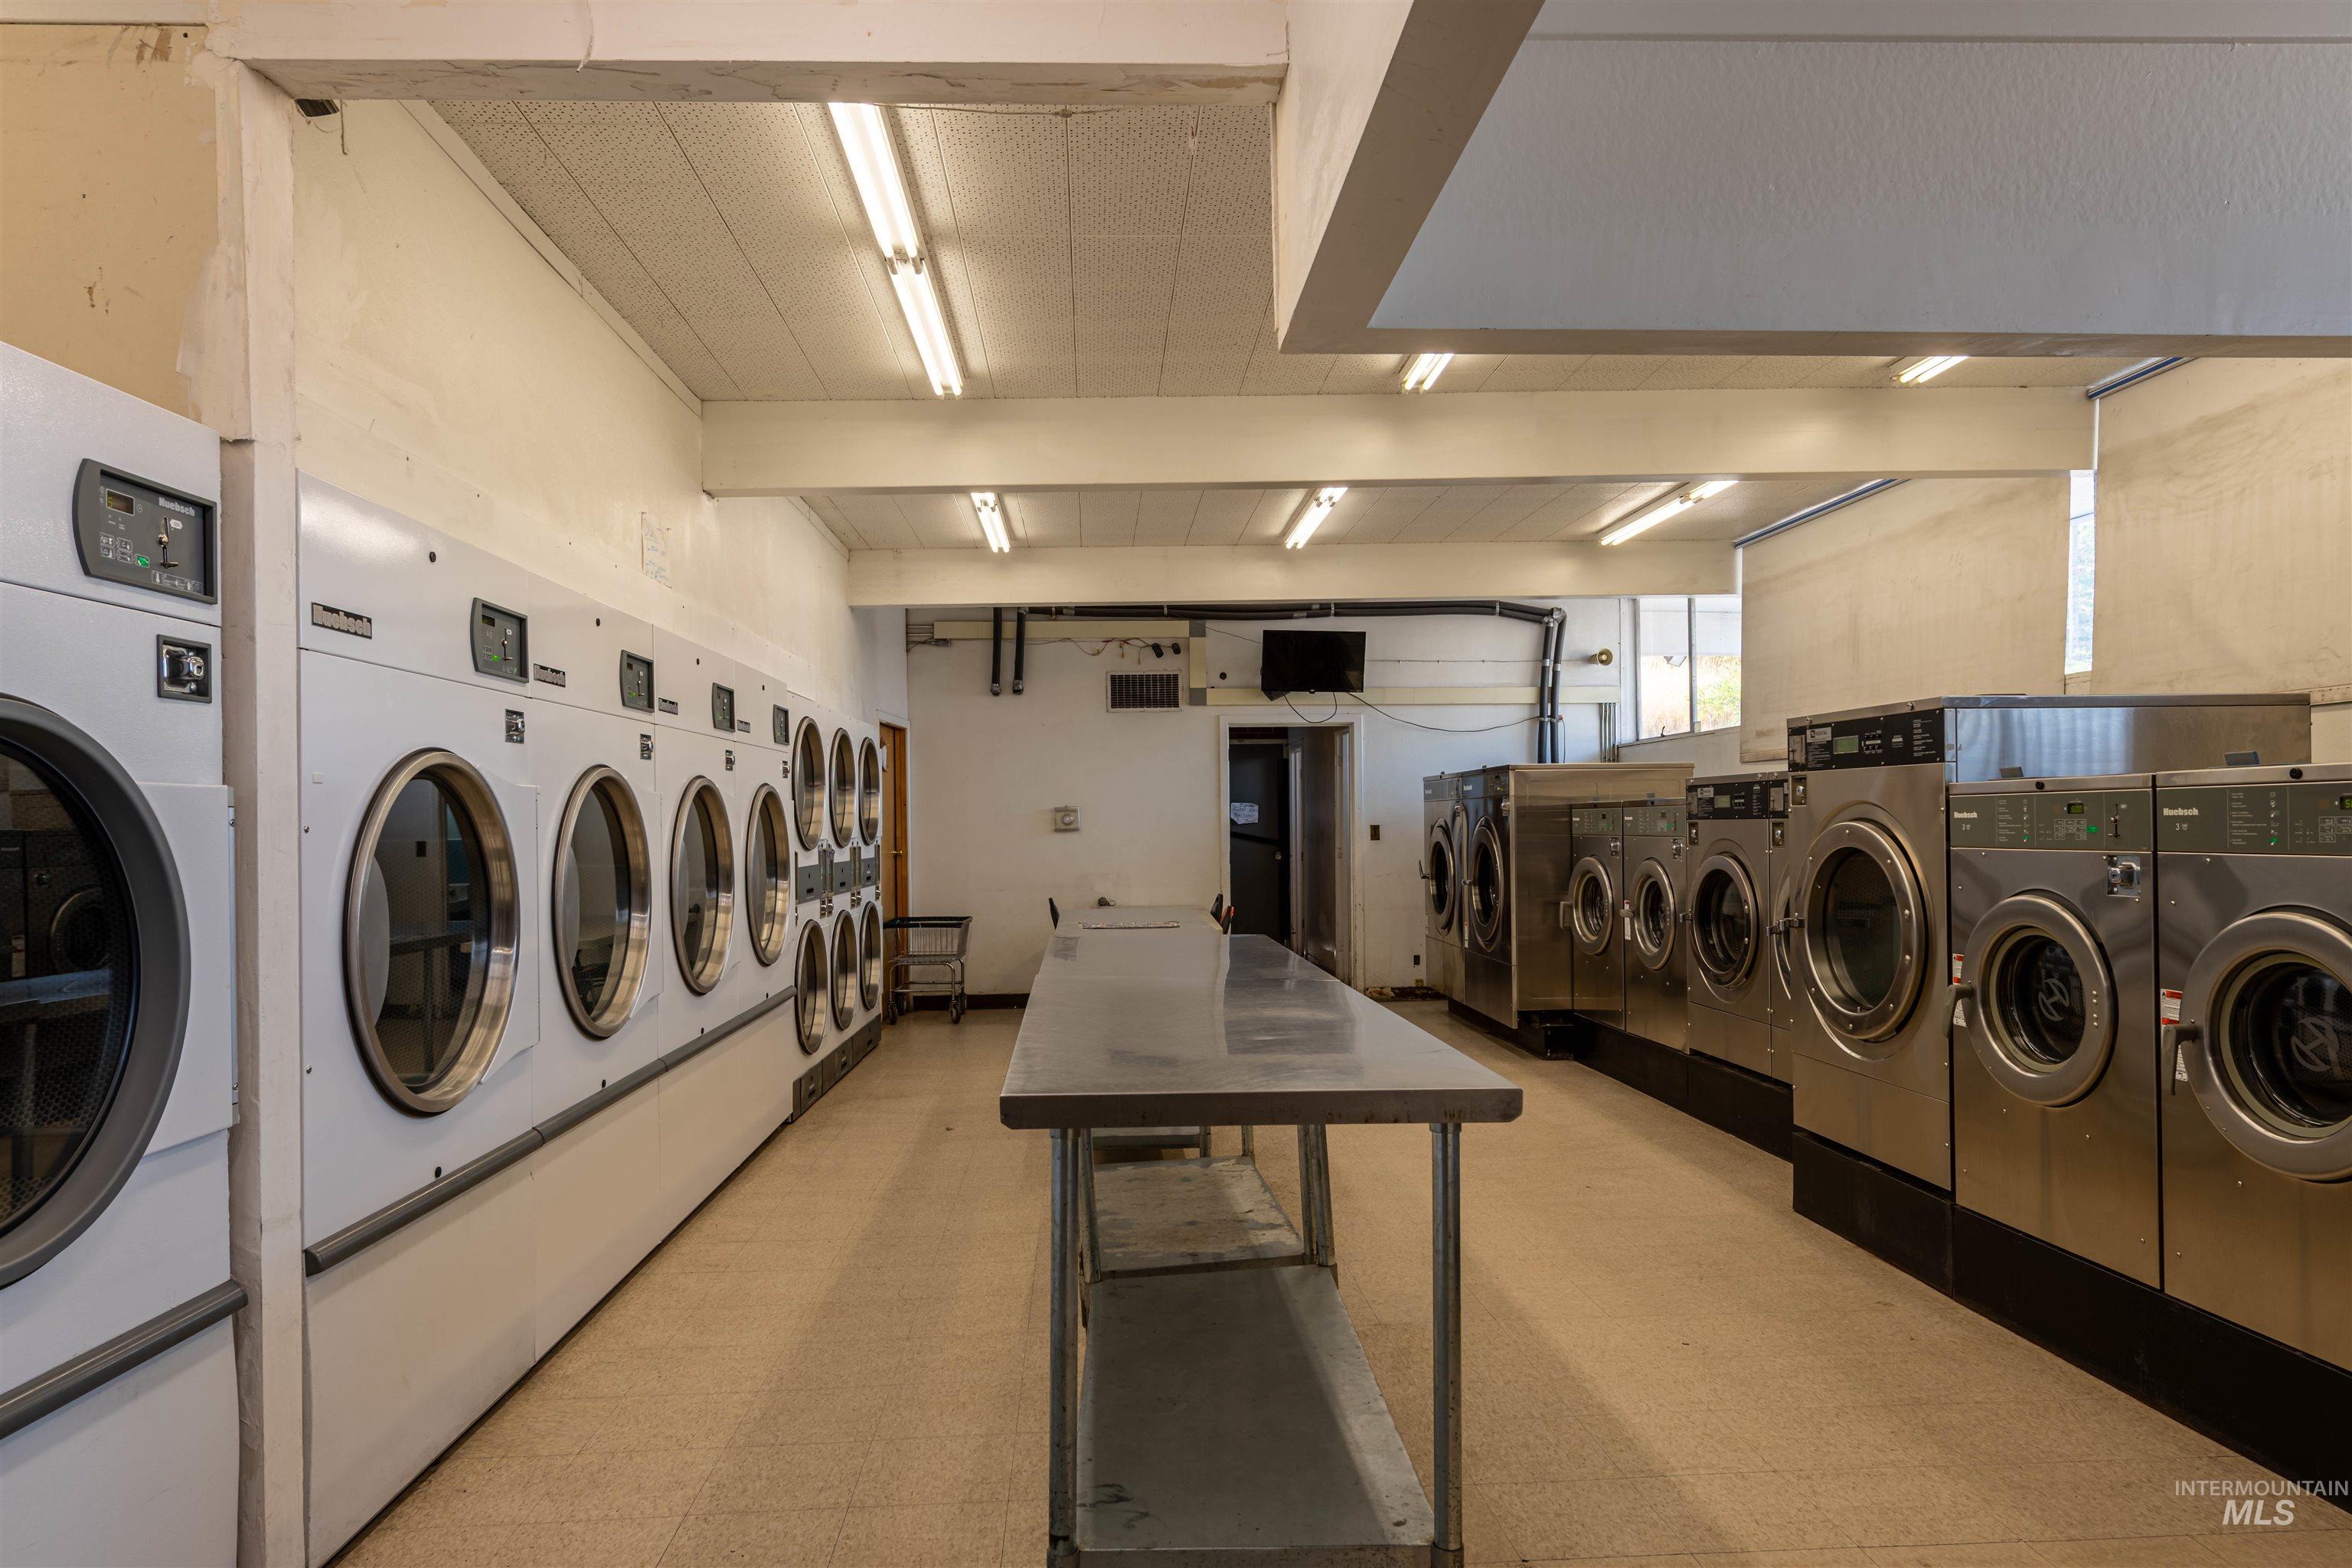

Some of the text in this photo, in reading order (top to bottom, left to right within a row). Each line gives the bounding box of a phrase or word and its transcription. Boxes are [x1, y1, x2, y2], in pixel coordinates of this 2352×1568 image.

[158, 497, 195, 517] Huebsch
[312, 604, 371, 637] Huebsch
[2163, 807, 2199, 816] Huebsch
